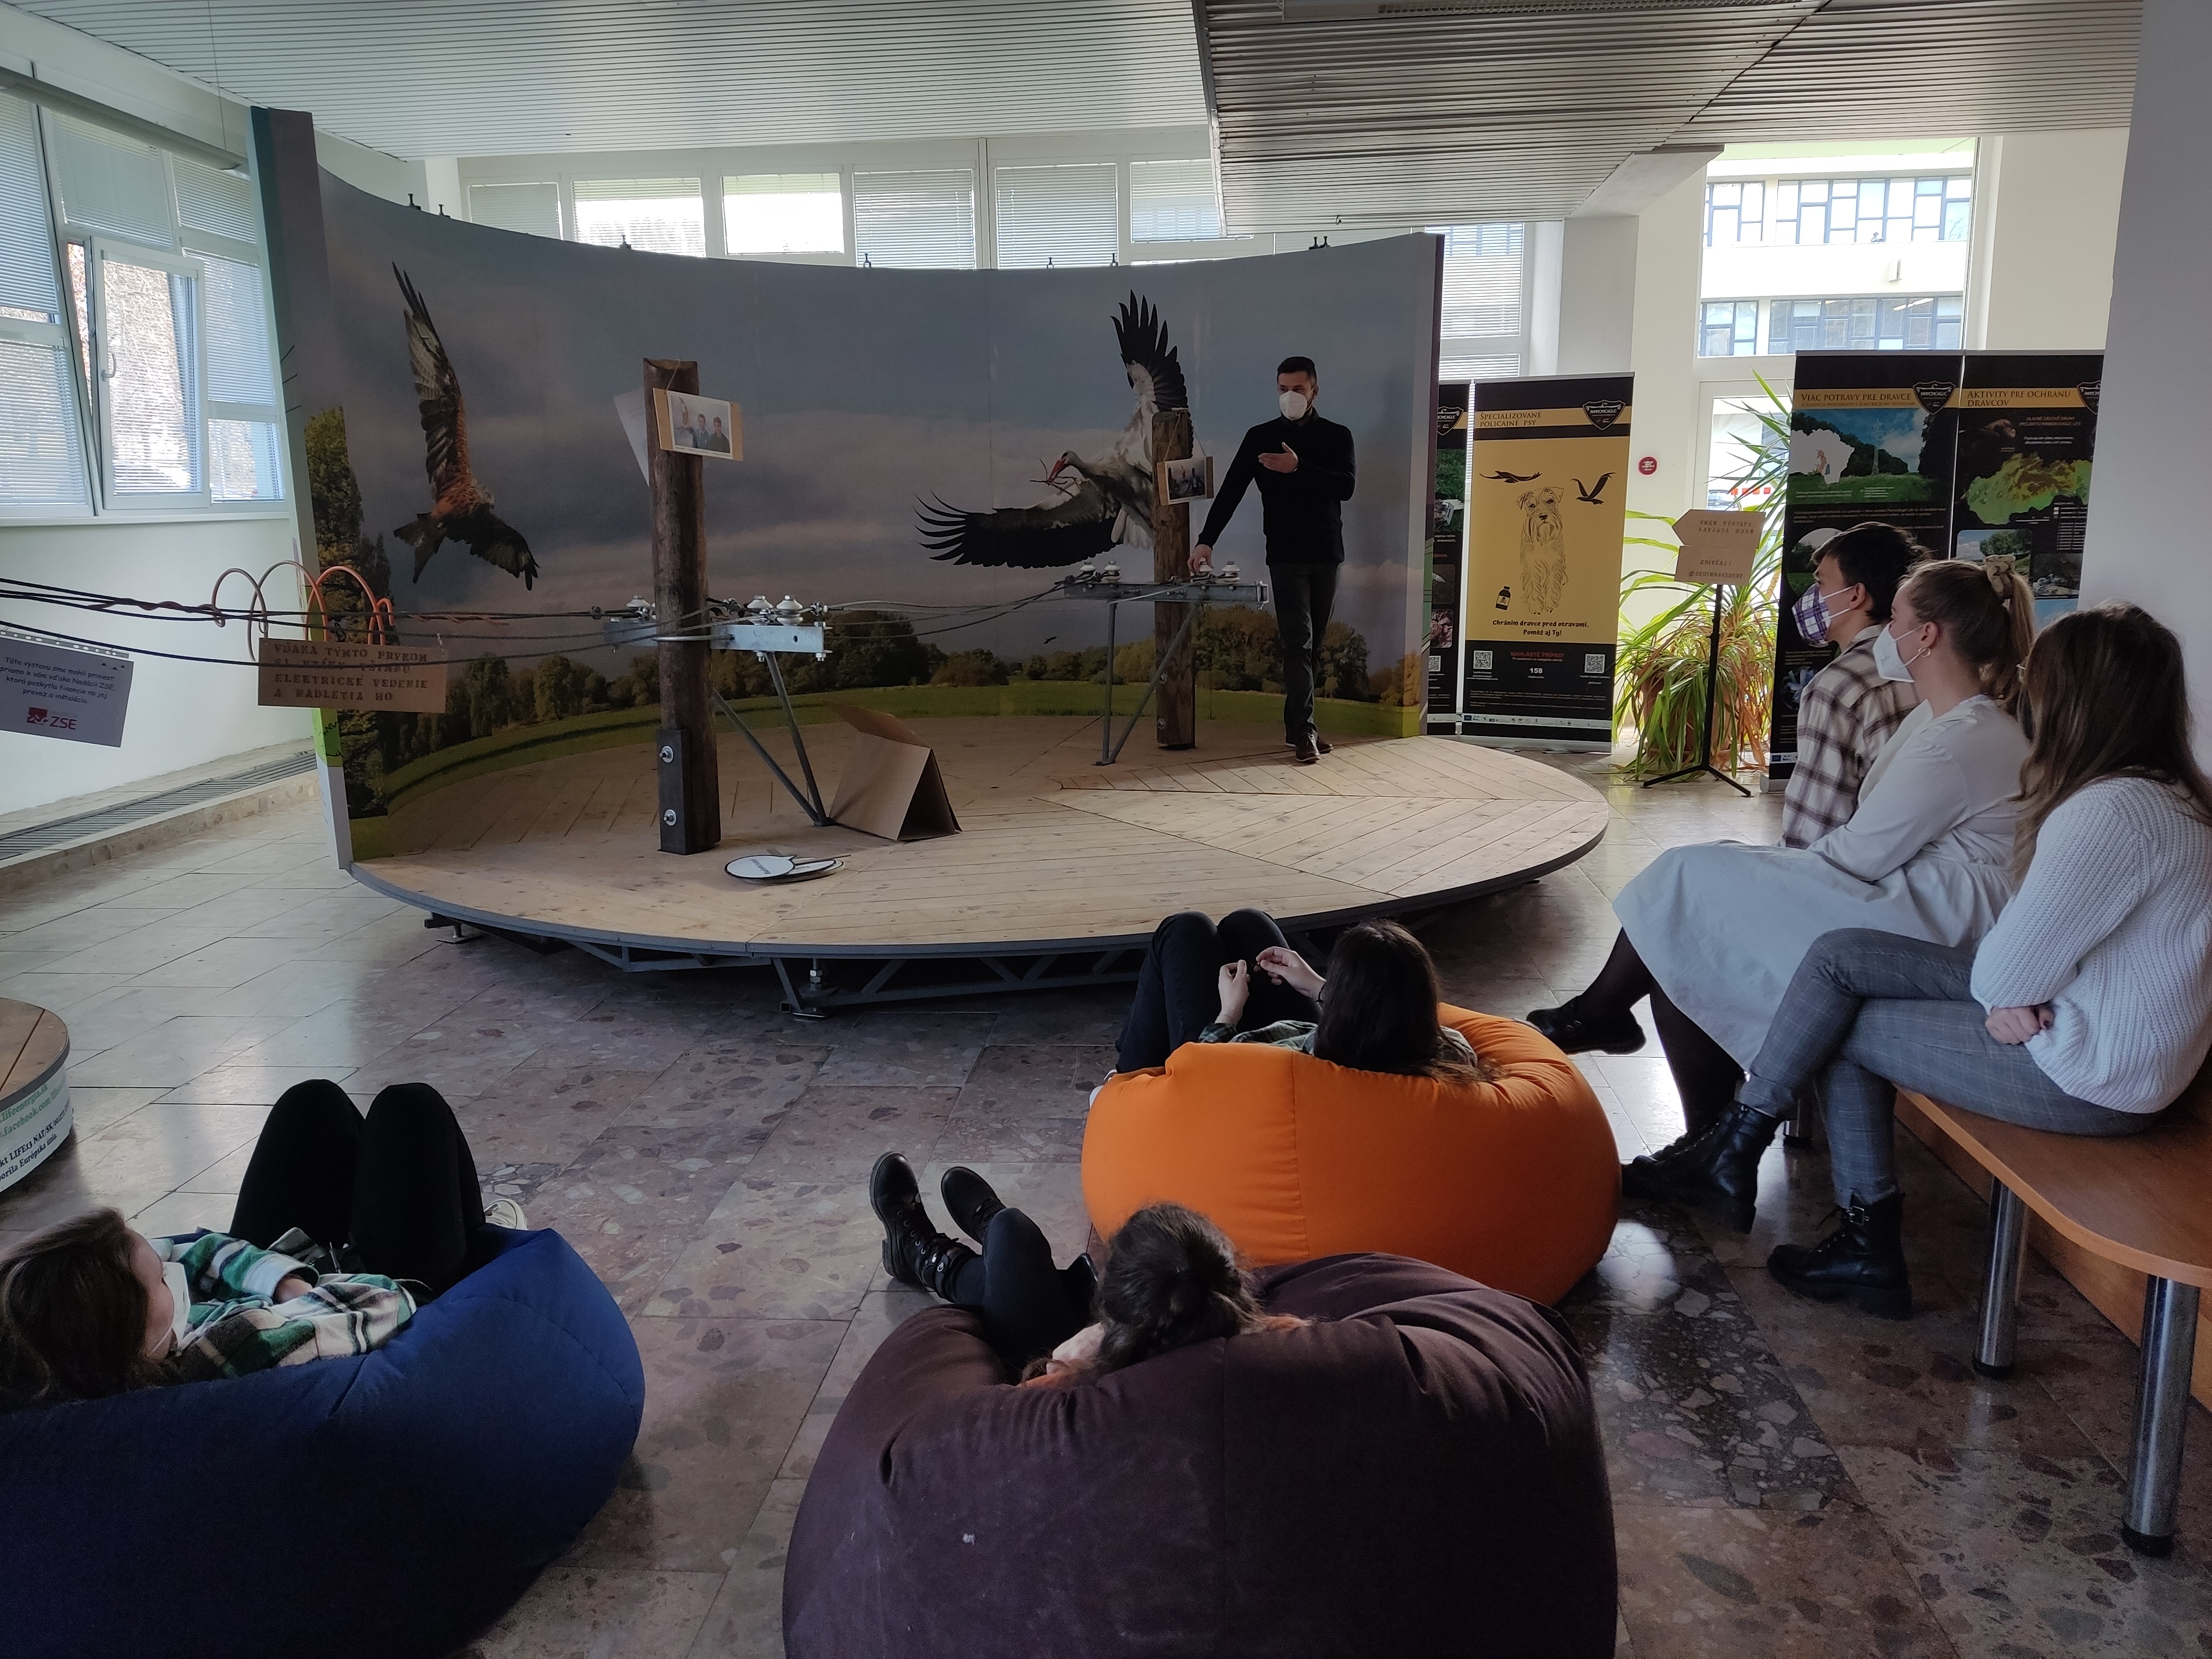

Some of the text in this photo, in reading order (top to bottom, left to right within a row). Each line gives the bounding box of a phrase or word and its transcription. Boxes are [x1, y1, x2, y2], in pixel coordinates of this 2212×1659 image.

[1480, 419, 1519, 427] POLICAJNÉ
[274, 643, 318, 655] VĎAKA
[325, 646, 368, 658] TÝMTO
[6, 657, 22, 665] Túto
[24, 661, 50, 670] výstavu
[0, 666, 24, 675] priamo
[49, 675, 70, 683] vďaka
[72, 678, 97, 687] Nadácii
[275, 674, 427, 689] ELEKTRICKÉ VEDENIE
[6, 676, 25, 684] ktorá
[28, 681, 57, 690] poskytla
[59, 685, 86, 693] financie
[23, 688, 48, 697] prevoz
[274, 689, 393, 701] A NADLETIA HO
[50, 716, 77, 730] ZSE
[19, 1143, 46, 1168] Európska
